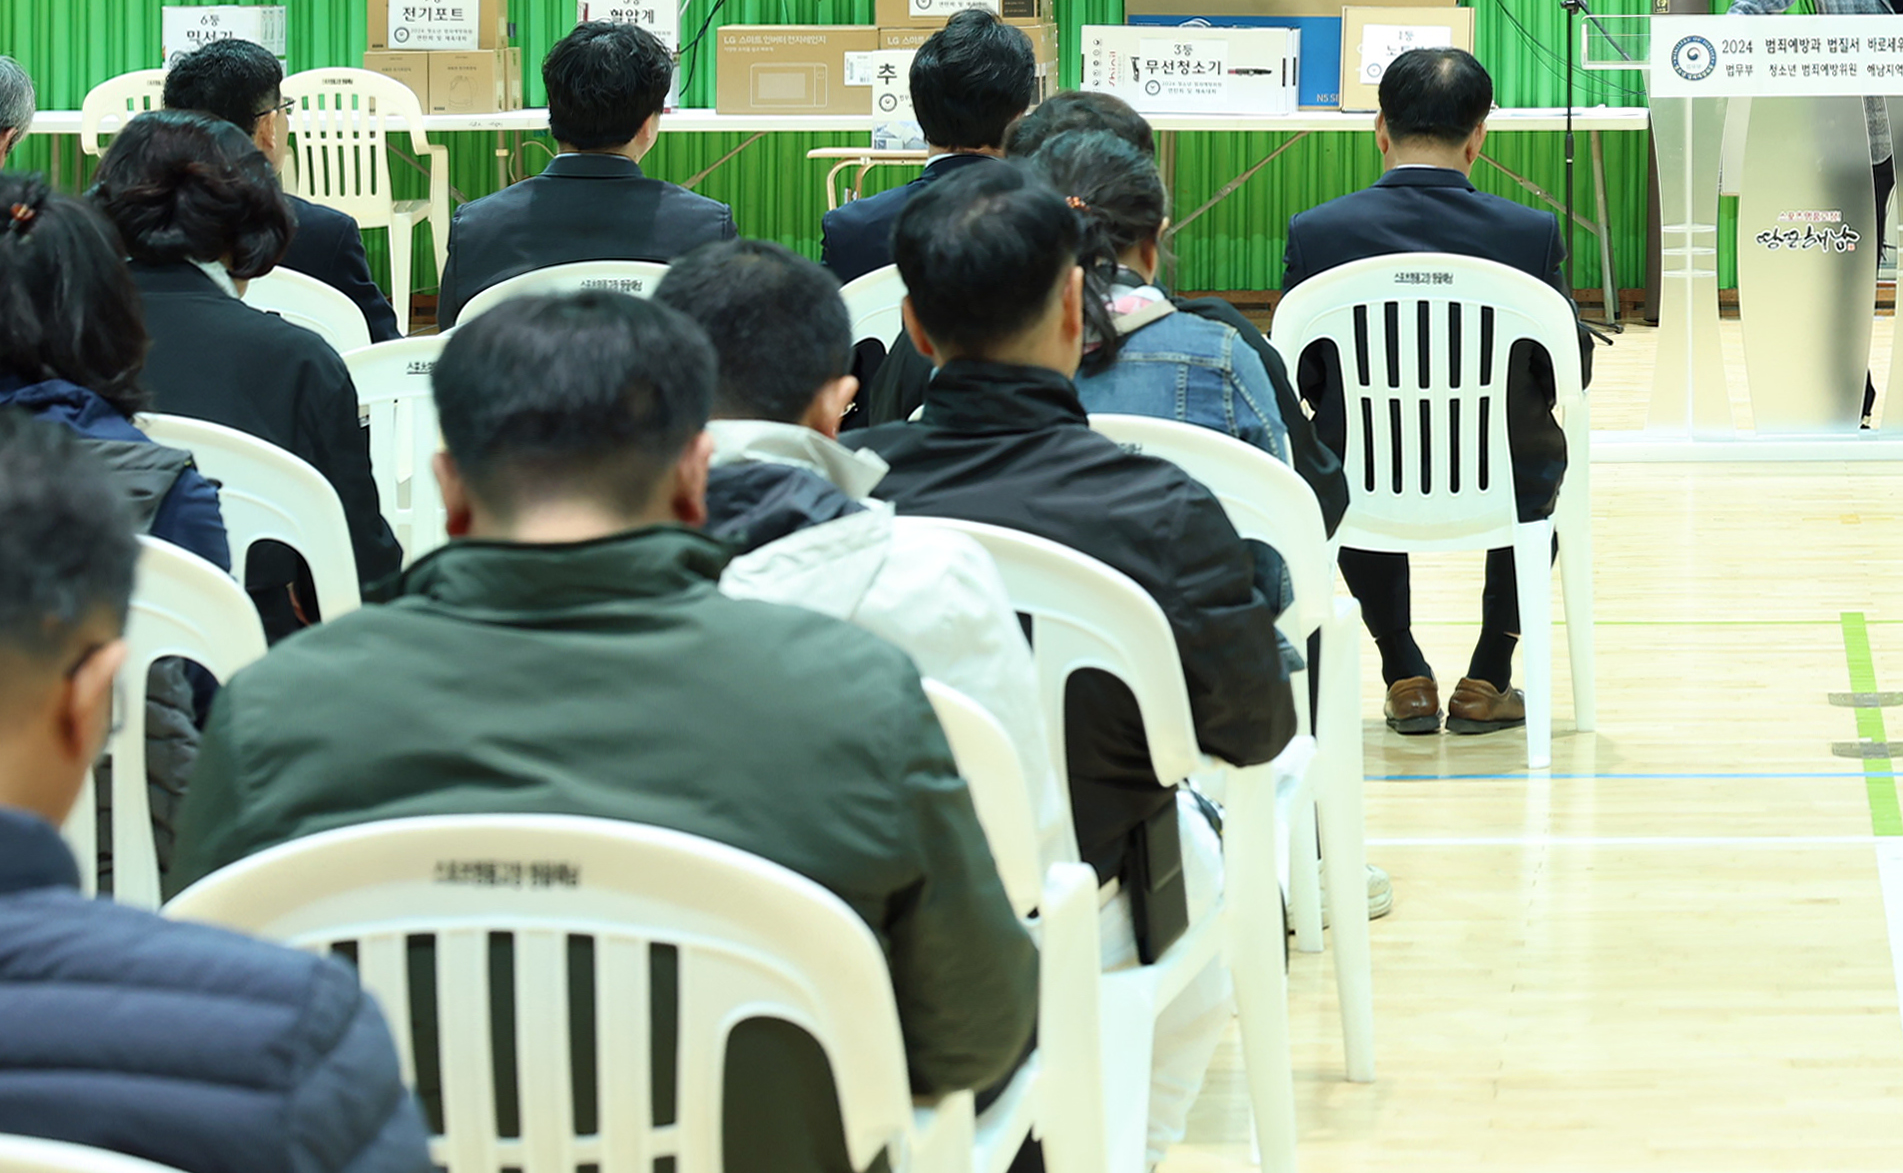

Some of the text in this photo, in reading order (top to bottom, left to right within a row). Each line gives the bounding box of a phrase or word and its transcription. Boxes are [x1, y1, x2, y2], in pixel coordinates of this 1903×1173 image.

[402, 7, 465, 22] 전기포트
[610, 9, 654, 24] 혈압계
[724, 36, 736, 44] LG
[887, 37, 899, 45] LG
[1722, 39, 1753, 54] 2024
[1765, 37, 1821, 54] 범죄예방과
[1827, 37, 1860, 53] 법질서
[1174, 44, 1193, 56] 3등
[1145, 59, 1221, 75] 무선청소기
[1725, 63, 1753, 77] 법무부
[1769, 63, 1797, 77] 청소년
[1801, 63, 1857, 77] 범죄예방위원
